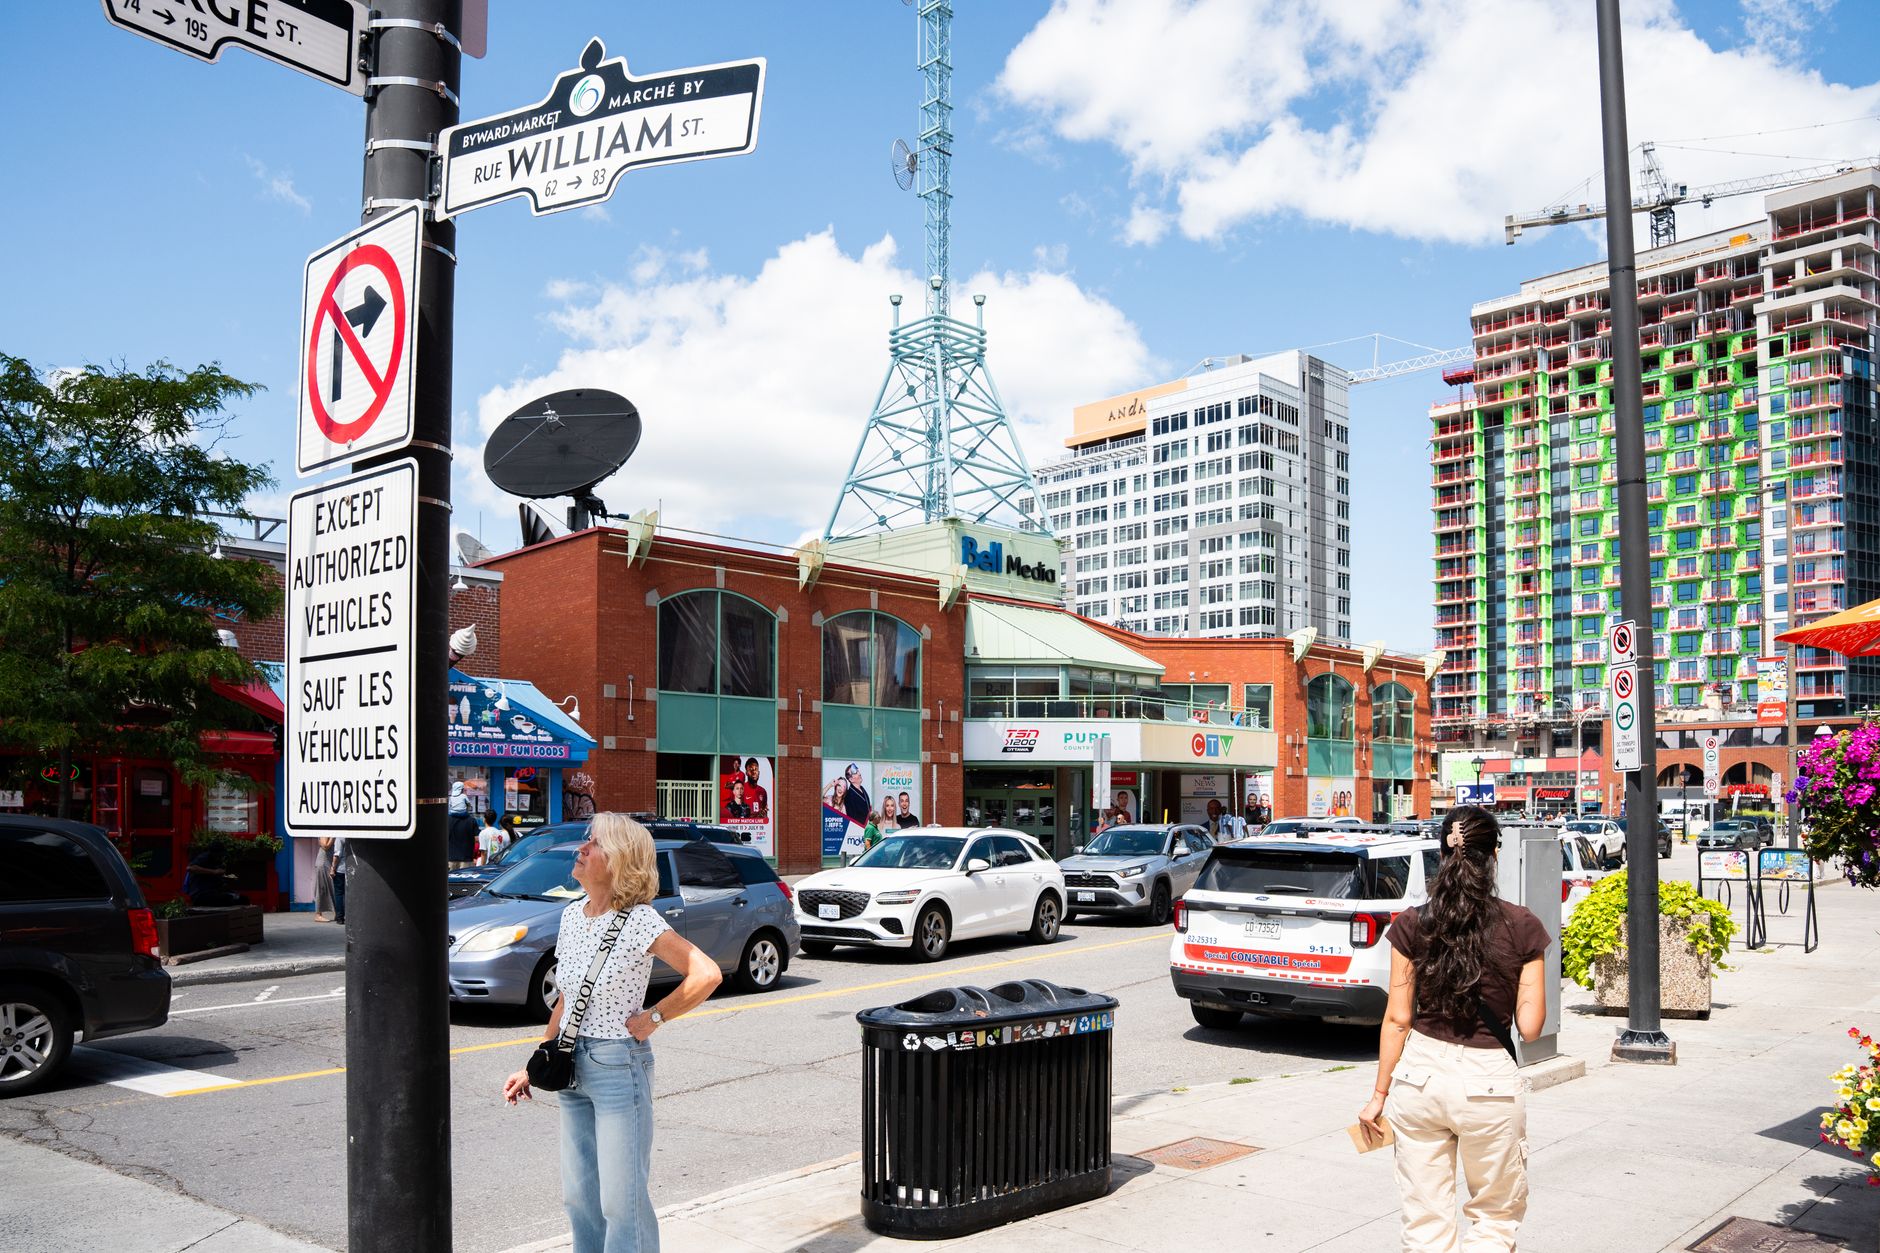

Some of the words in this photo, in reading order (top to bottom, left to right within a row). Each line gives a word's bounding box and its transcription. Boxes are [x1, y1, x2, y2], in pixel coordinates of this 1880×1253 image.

[185, 17, 208, 42] 195
[275, 19, 302, 45] ST.
[608, 82, 675, 109] MARCHÉ
[683, 80, 704, 94] BY
[462, 125, 510, 148] BYWARD
[512, 111, 562, 135] MARKET
[473, 161, 502, 185] RUE
[508, 113, 673, 181] WILLIAM
[680, 117, 706, 137] ST.
[544, 180, 558, 197] 62
[592, 168, 606, 186] 83
[315, 487, 384, 536] EXCEPT
[293, 534, 407, 591] AUTHORIZED
[961, 535, 1003, 574] Bell
[1006, 554, 1056, 583] Media
[305, 591, 393, 638] VEHICLES
[303, 675, 347, 713] SAUF
[359, 670, 393, 707] LES
[298, 721, 398, 764] VÉHICULES
[454, 742, 490, 754] CREAM
[510, 745, 530, 756] FUN
[533, 746, 564, 757] FOODS
[1193, 735, 1232, 755] CTV
[513, 766, 536, 780] OPEN
[882, 777, 913, 785] PICKUP
[299, 769, 398, 815] AUTORISÉS
[1763, 852, 1783, 861] OWL
[1204, 951, 1228, 961] Special
[1231, 951, 1289, 966] CONSTABLE
[1292, 959, 1321, 969] Spécial
[1309, 945, 1334, 955] 9-1-1
